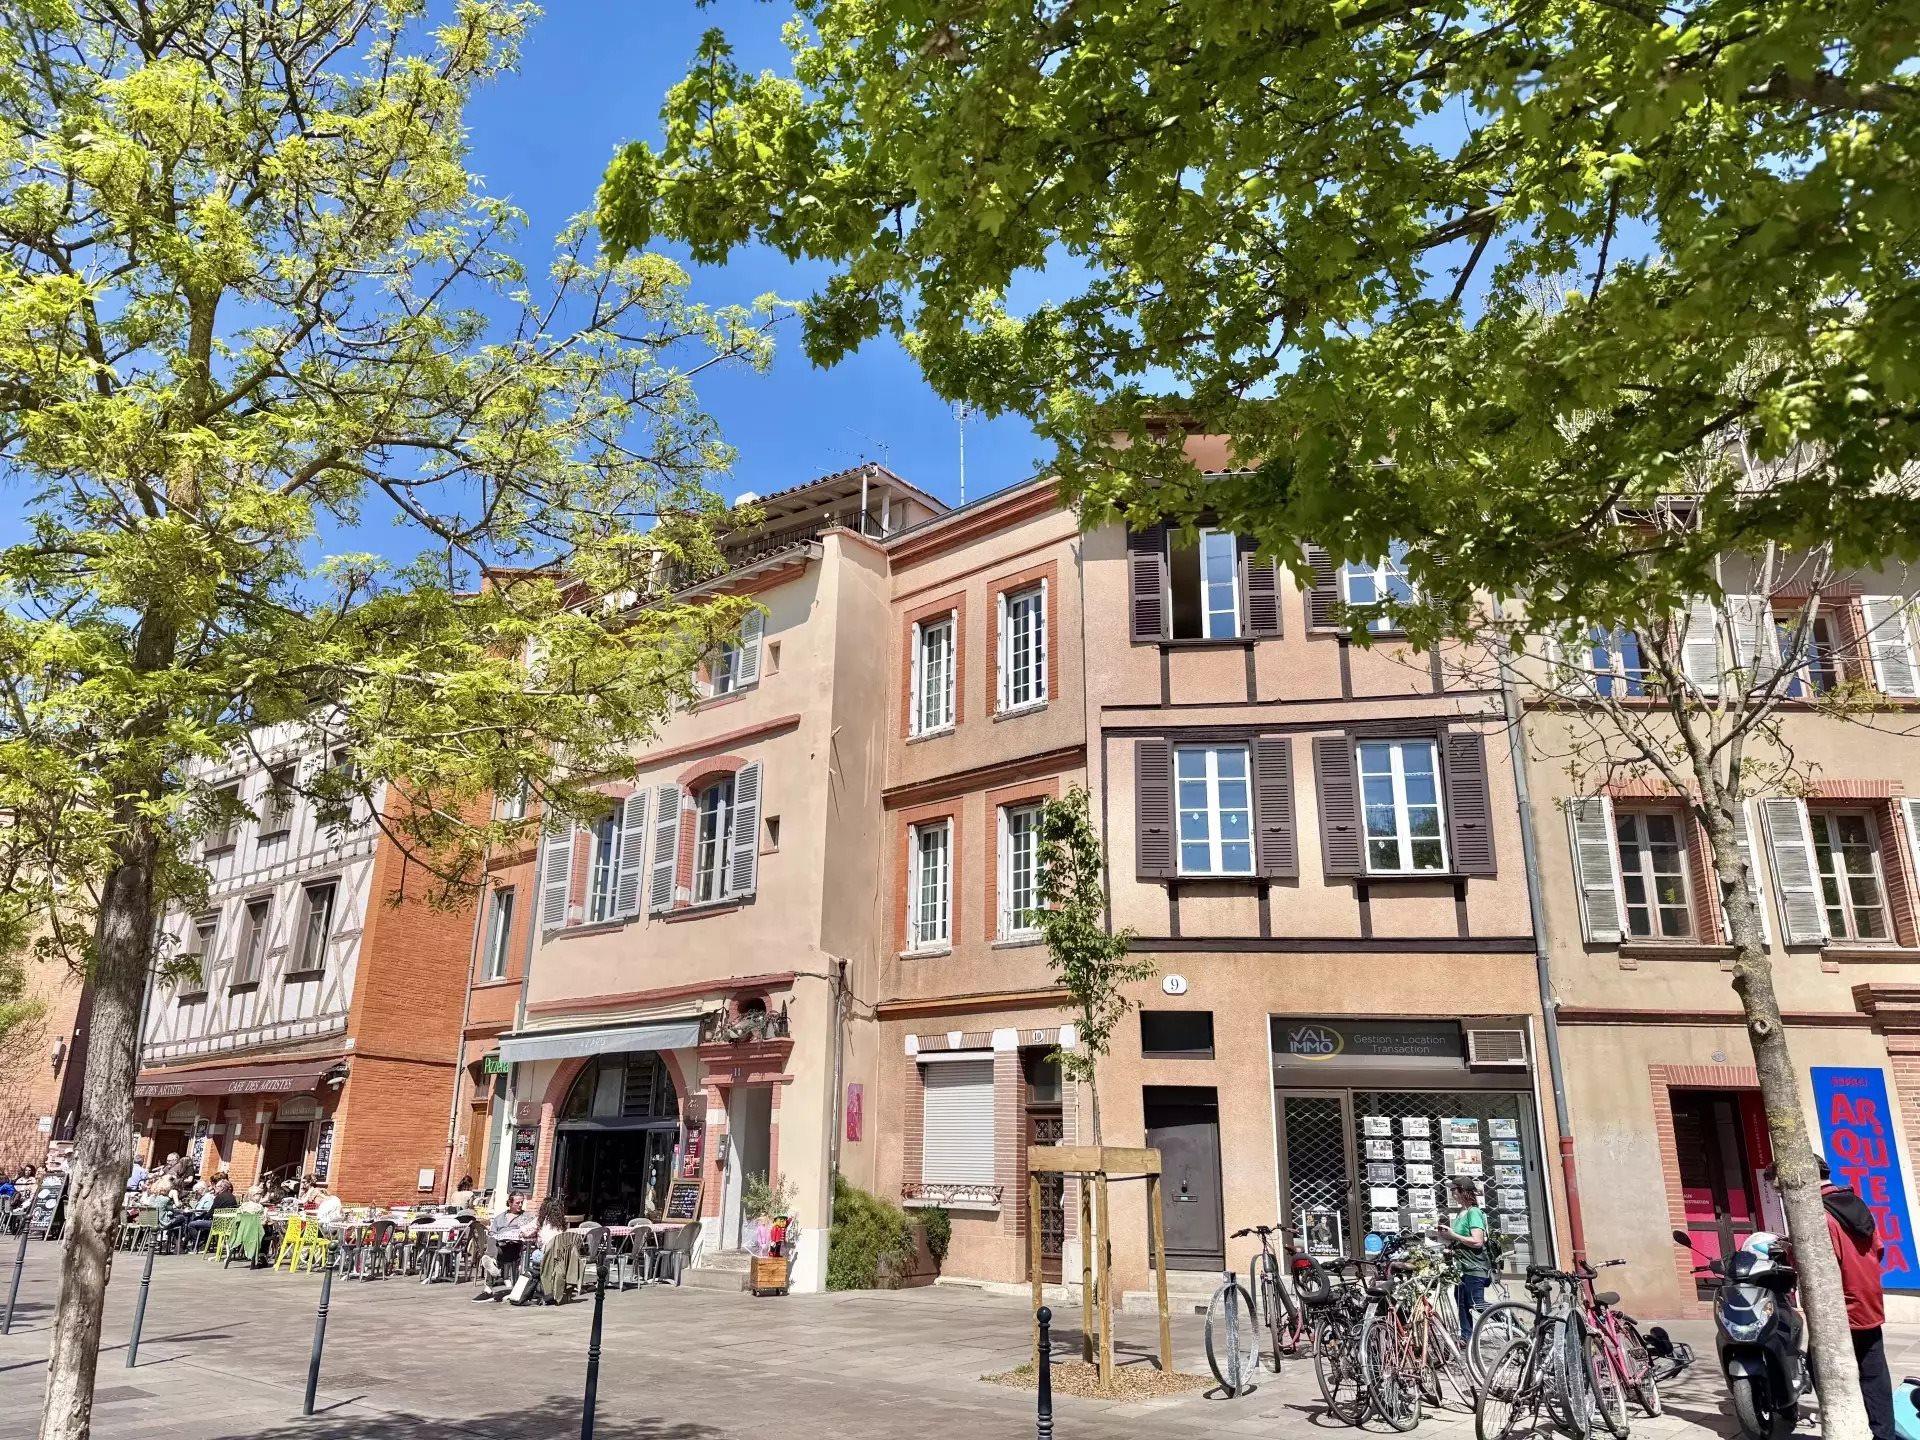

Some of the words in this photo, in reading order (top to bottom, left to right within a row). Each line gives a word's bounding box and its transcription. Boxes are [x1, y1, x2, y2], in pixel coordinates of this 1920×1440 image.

[1170, 975, 1179, 991] 9
[1034, 1032, 1042, 1041] 10
[1290, 1026, 1331, 1041] VAL
[1353, 1034, 1391, 1044] Gestion
[1402, 1035, 1445, 1045] Location
[1290, 1041, 1334, 1053] IMMO
[1372, 1044, 1430, 1054] Transaction
[244, 1079, 259, 1091] DES
[260, 1078, 294, 1090] ARTISTES
